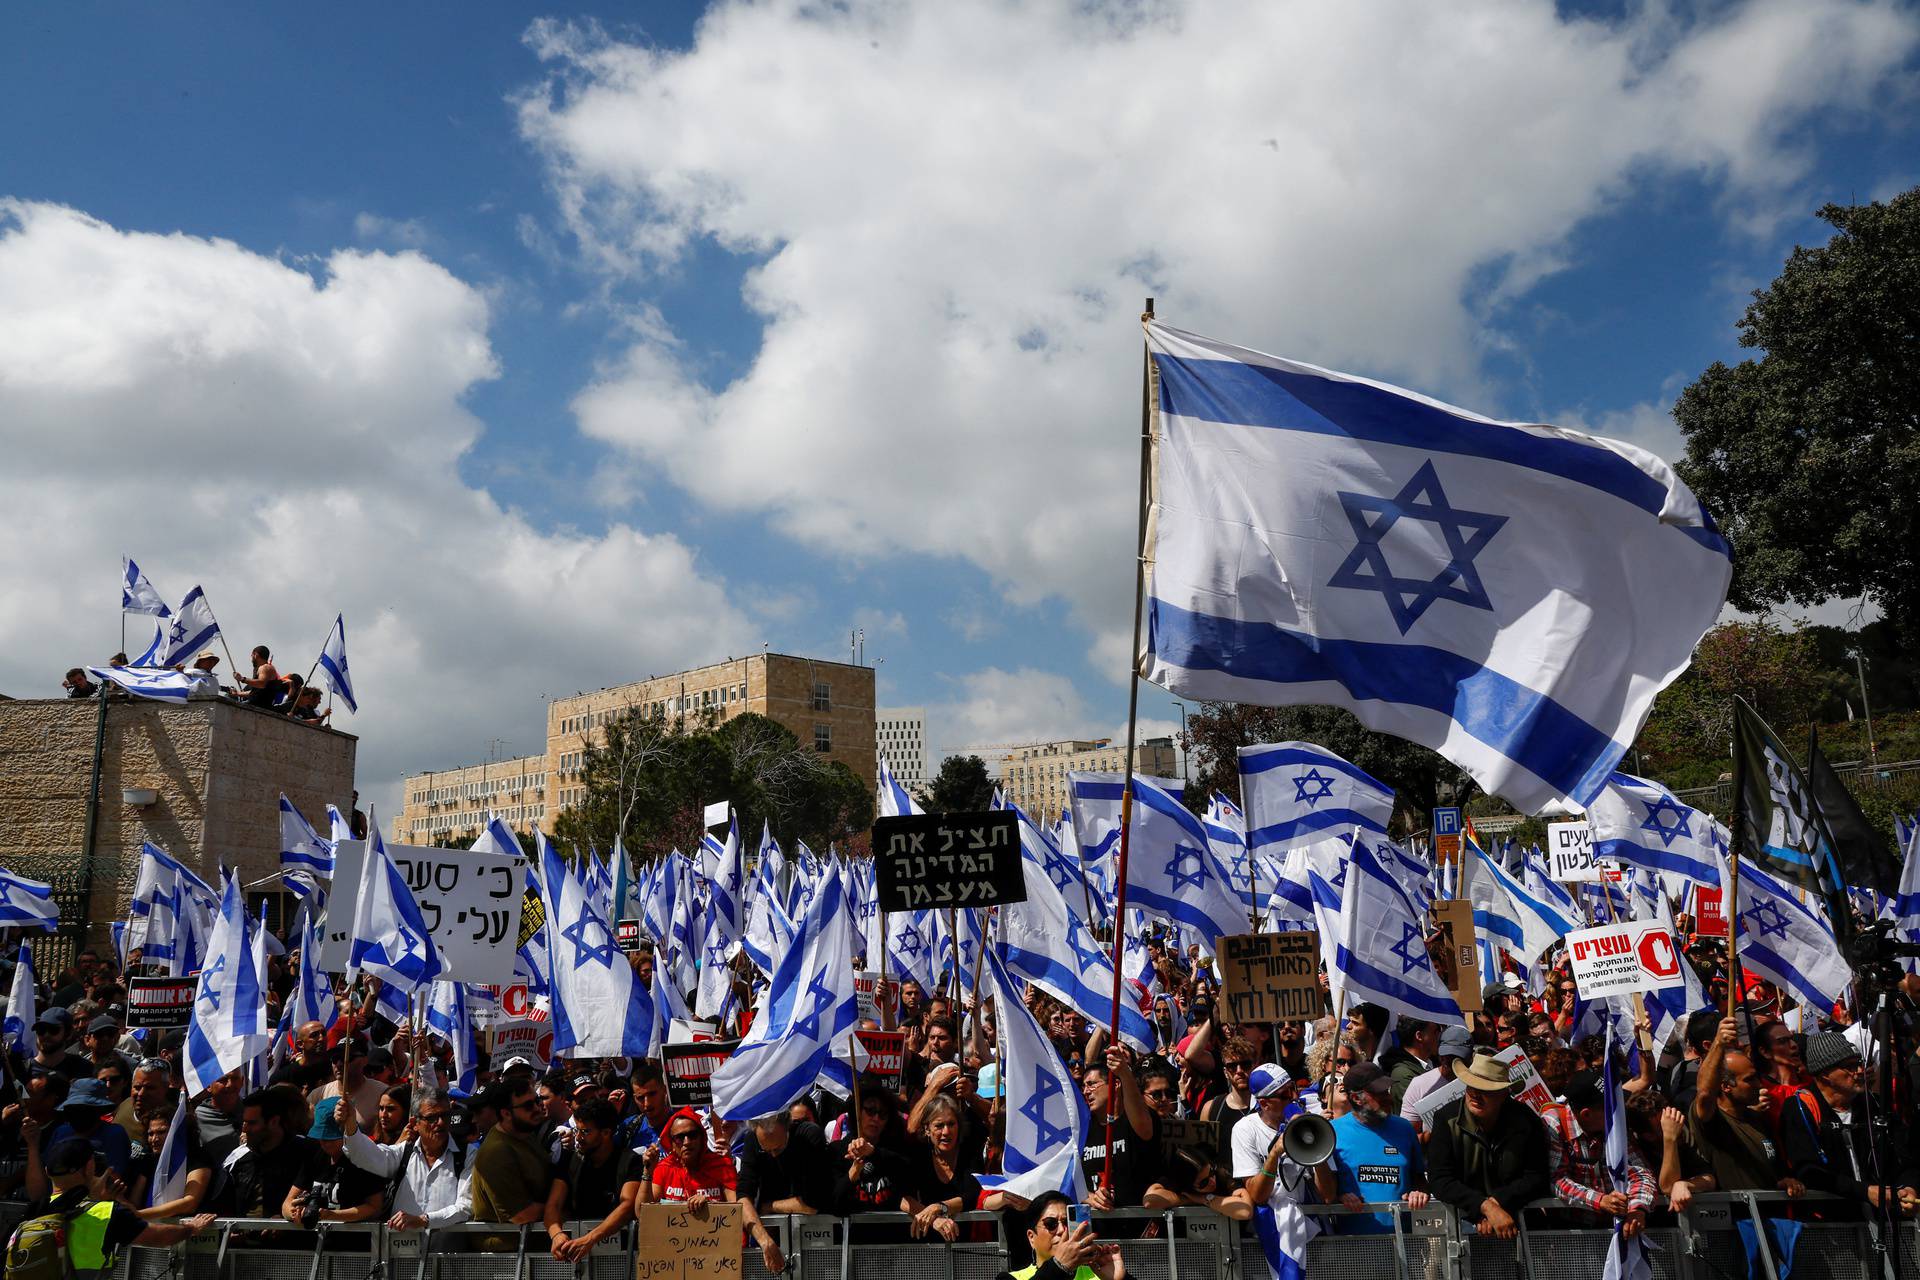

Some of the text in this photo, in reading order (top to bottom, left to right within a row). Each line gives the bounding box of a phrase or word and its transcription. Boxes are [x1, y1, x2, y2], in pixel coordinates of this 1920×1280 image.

[886, 825, 1009, 856] תציל את
[1559, 830, 1591, 848] שעים
[895, 853, 994, 878] המדינה
[896, 881, 998, 908] מעצמך
[1277, 936, 1313, 953] ביבי
[1573, 934, 1632, 961] עוצרים
[1593, 957, 1624, 969] החקיקה
[1578, 964, 1638, 980] האנטי דמוקרטית
[1227, 985, 1264, 1024] לרוץ
[498, 1028, 538, 1045] עוצרים
[1360, 1174, 1398, 1183] אין הייטק
[667, 1212, 690, 1228] לא
[669, 1236, 719, 1253] מאמינה
[638, 1256, 738, 1280] שאני עדיין מפגינה
